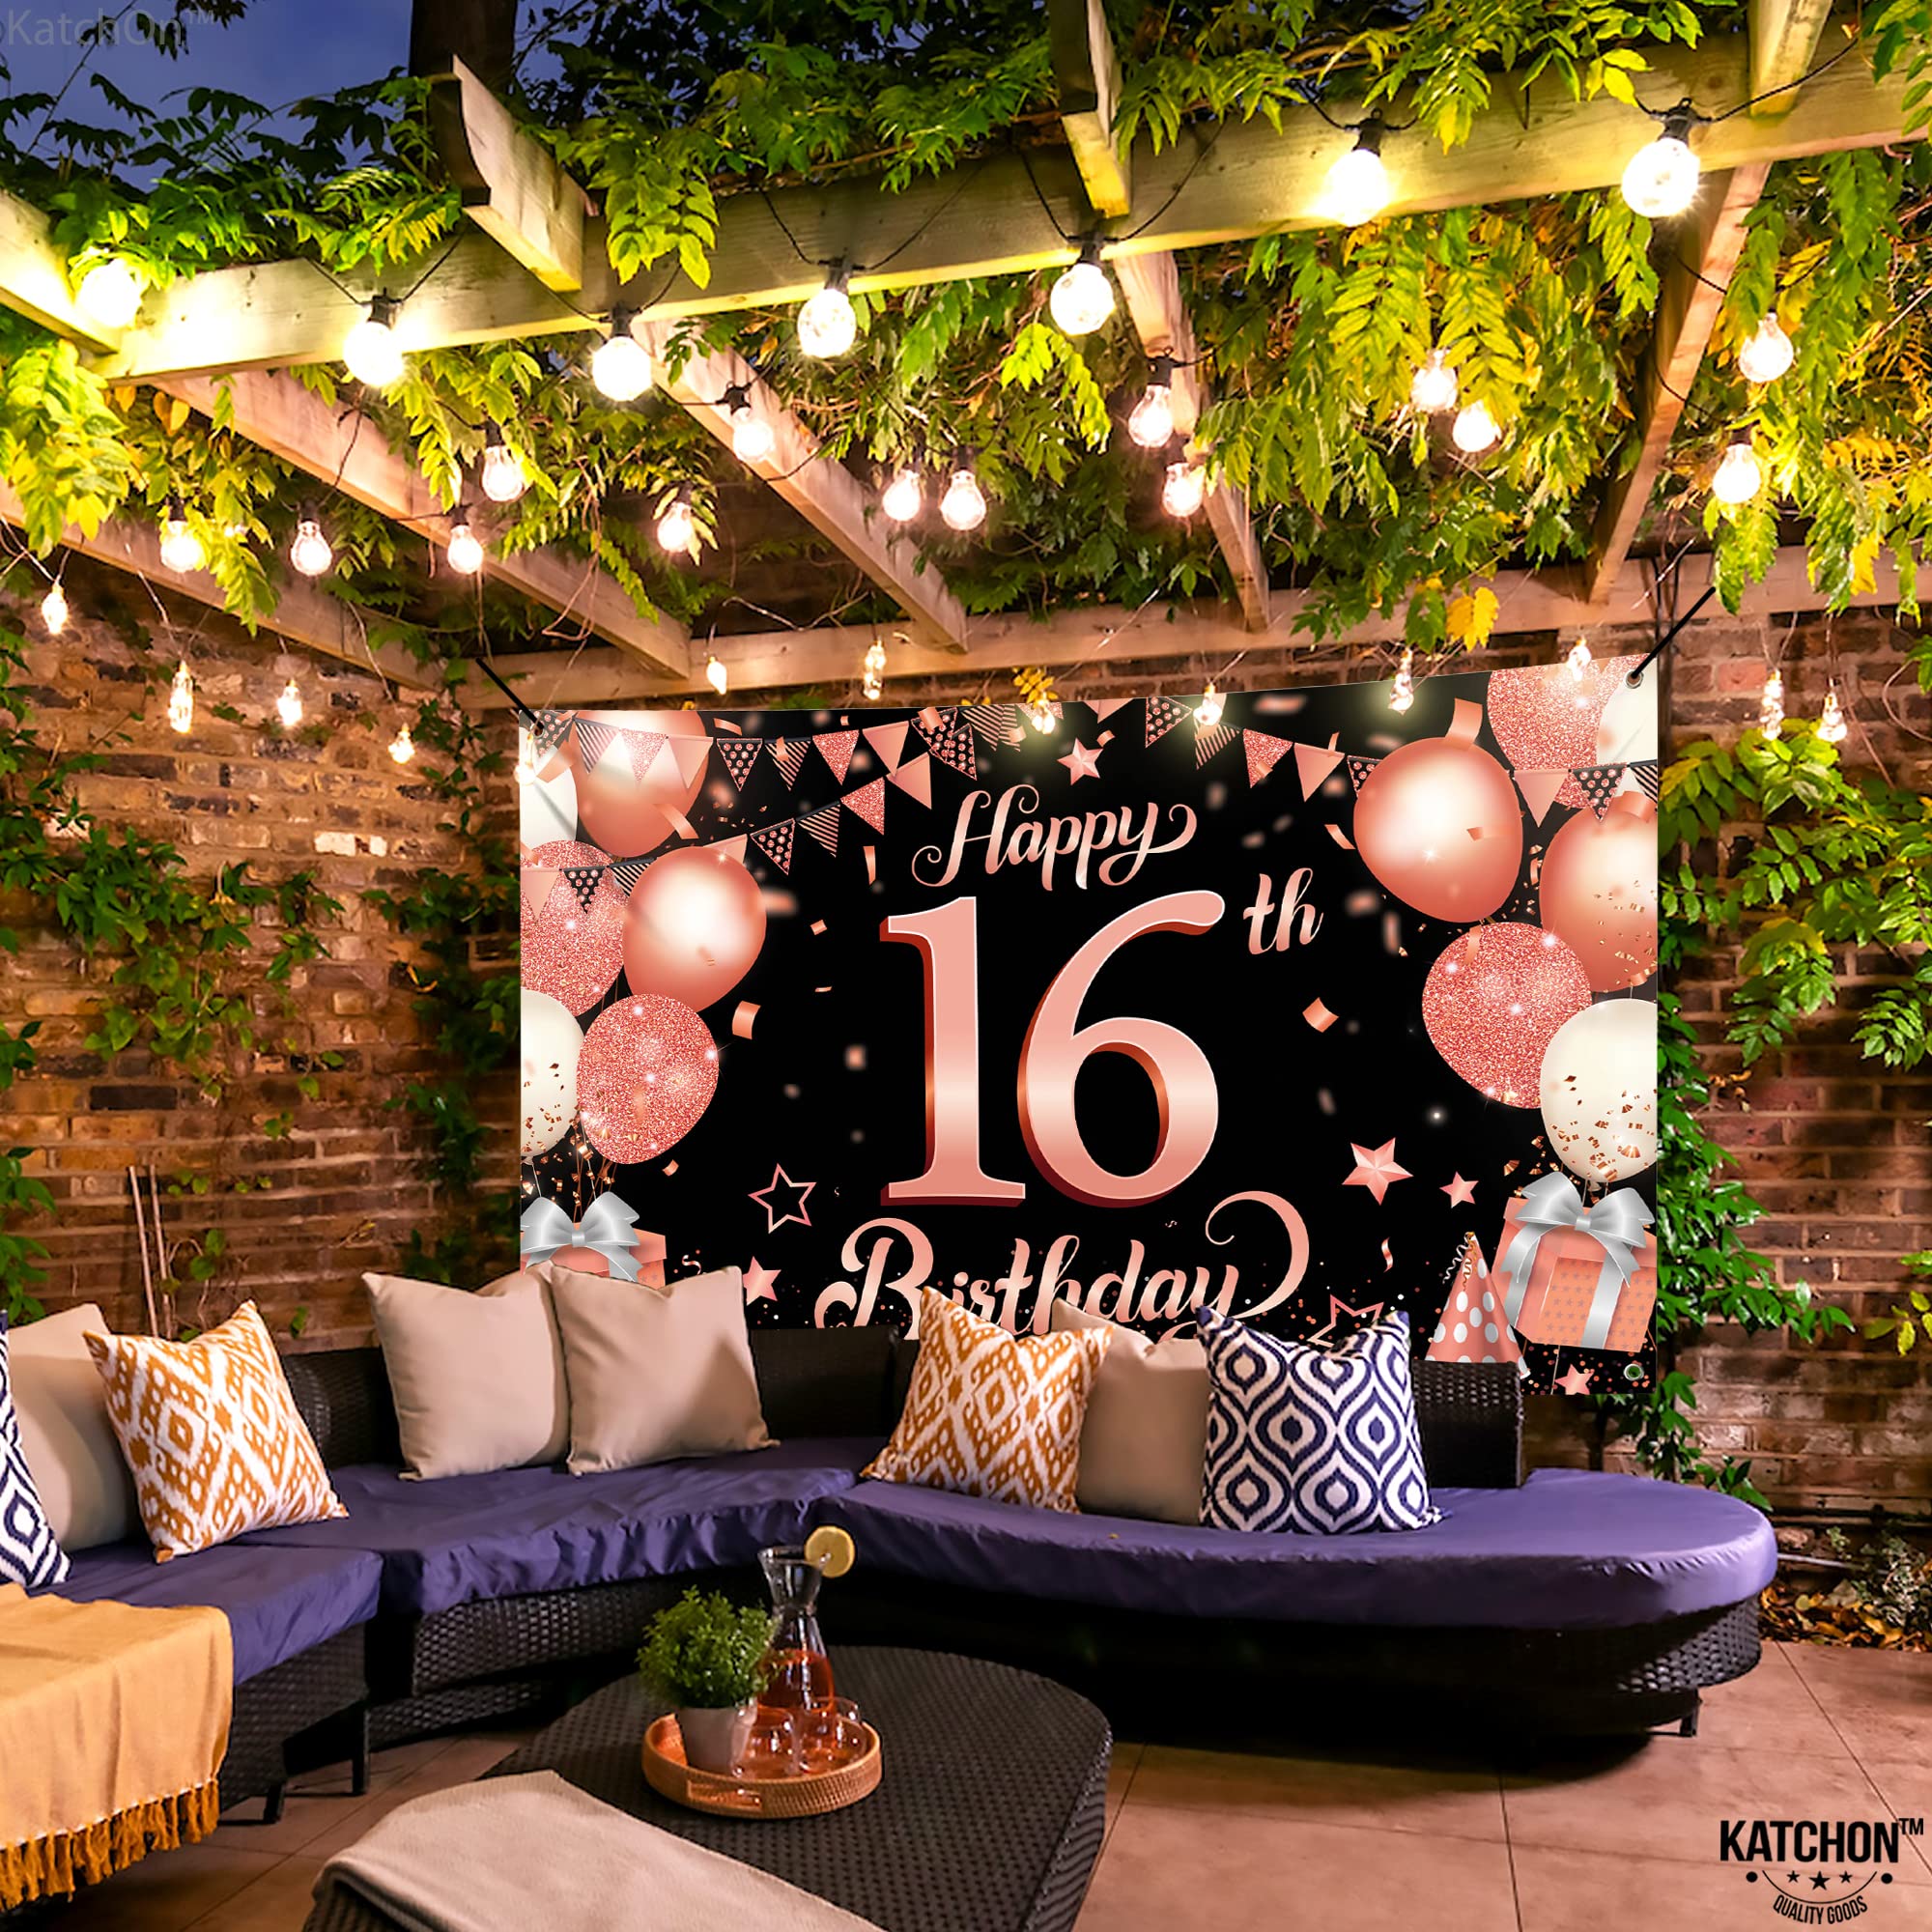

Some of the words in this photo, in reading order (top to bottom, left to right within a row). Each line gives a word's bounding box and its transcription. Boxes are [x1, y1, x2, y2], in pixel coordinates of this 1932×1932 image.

[911, 783, 1198, 892] Happy
[879, 889, 1226, 1208] 16
[1242, 867, 1324, 955] th
